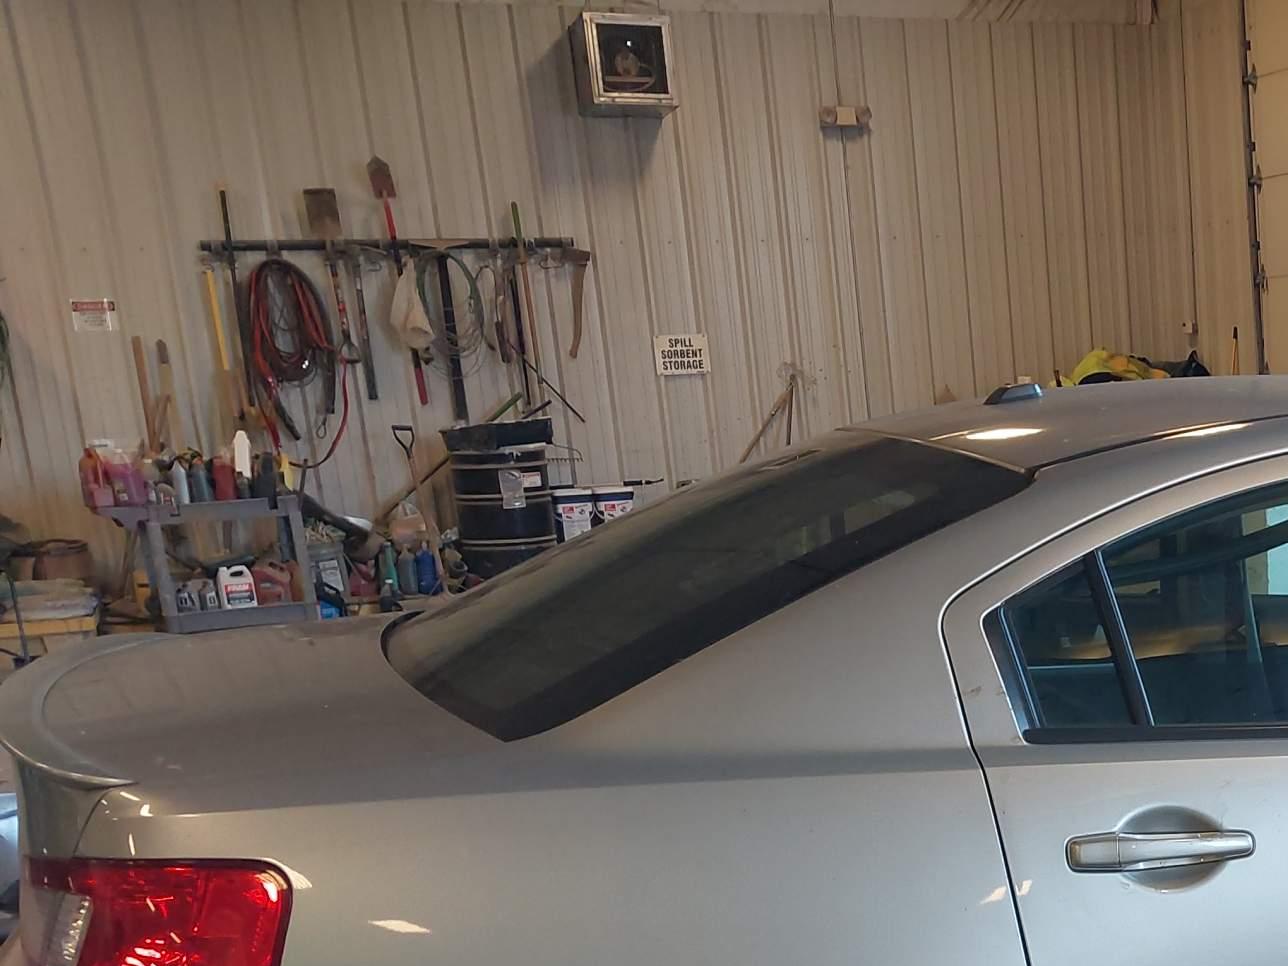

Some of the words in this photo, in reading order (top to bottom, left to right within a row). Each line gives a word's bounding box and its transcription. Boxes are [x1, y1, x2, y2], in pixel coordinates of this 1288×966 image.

[668, 337, 694, 348] SPILL
[661, 348, 703, 359] SORBENT
[662, 359, 704, 370] STORAGE
